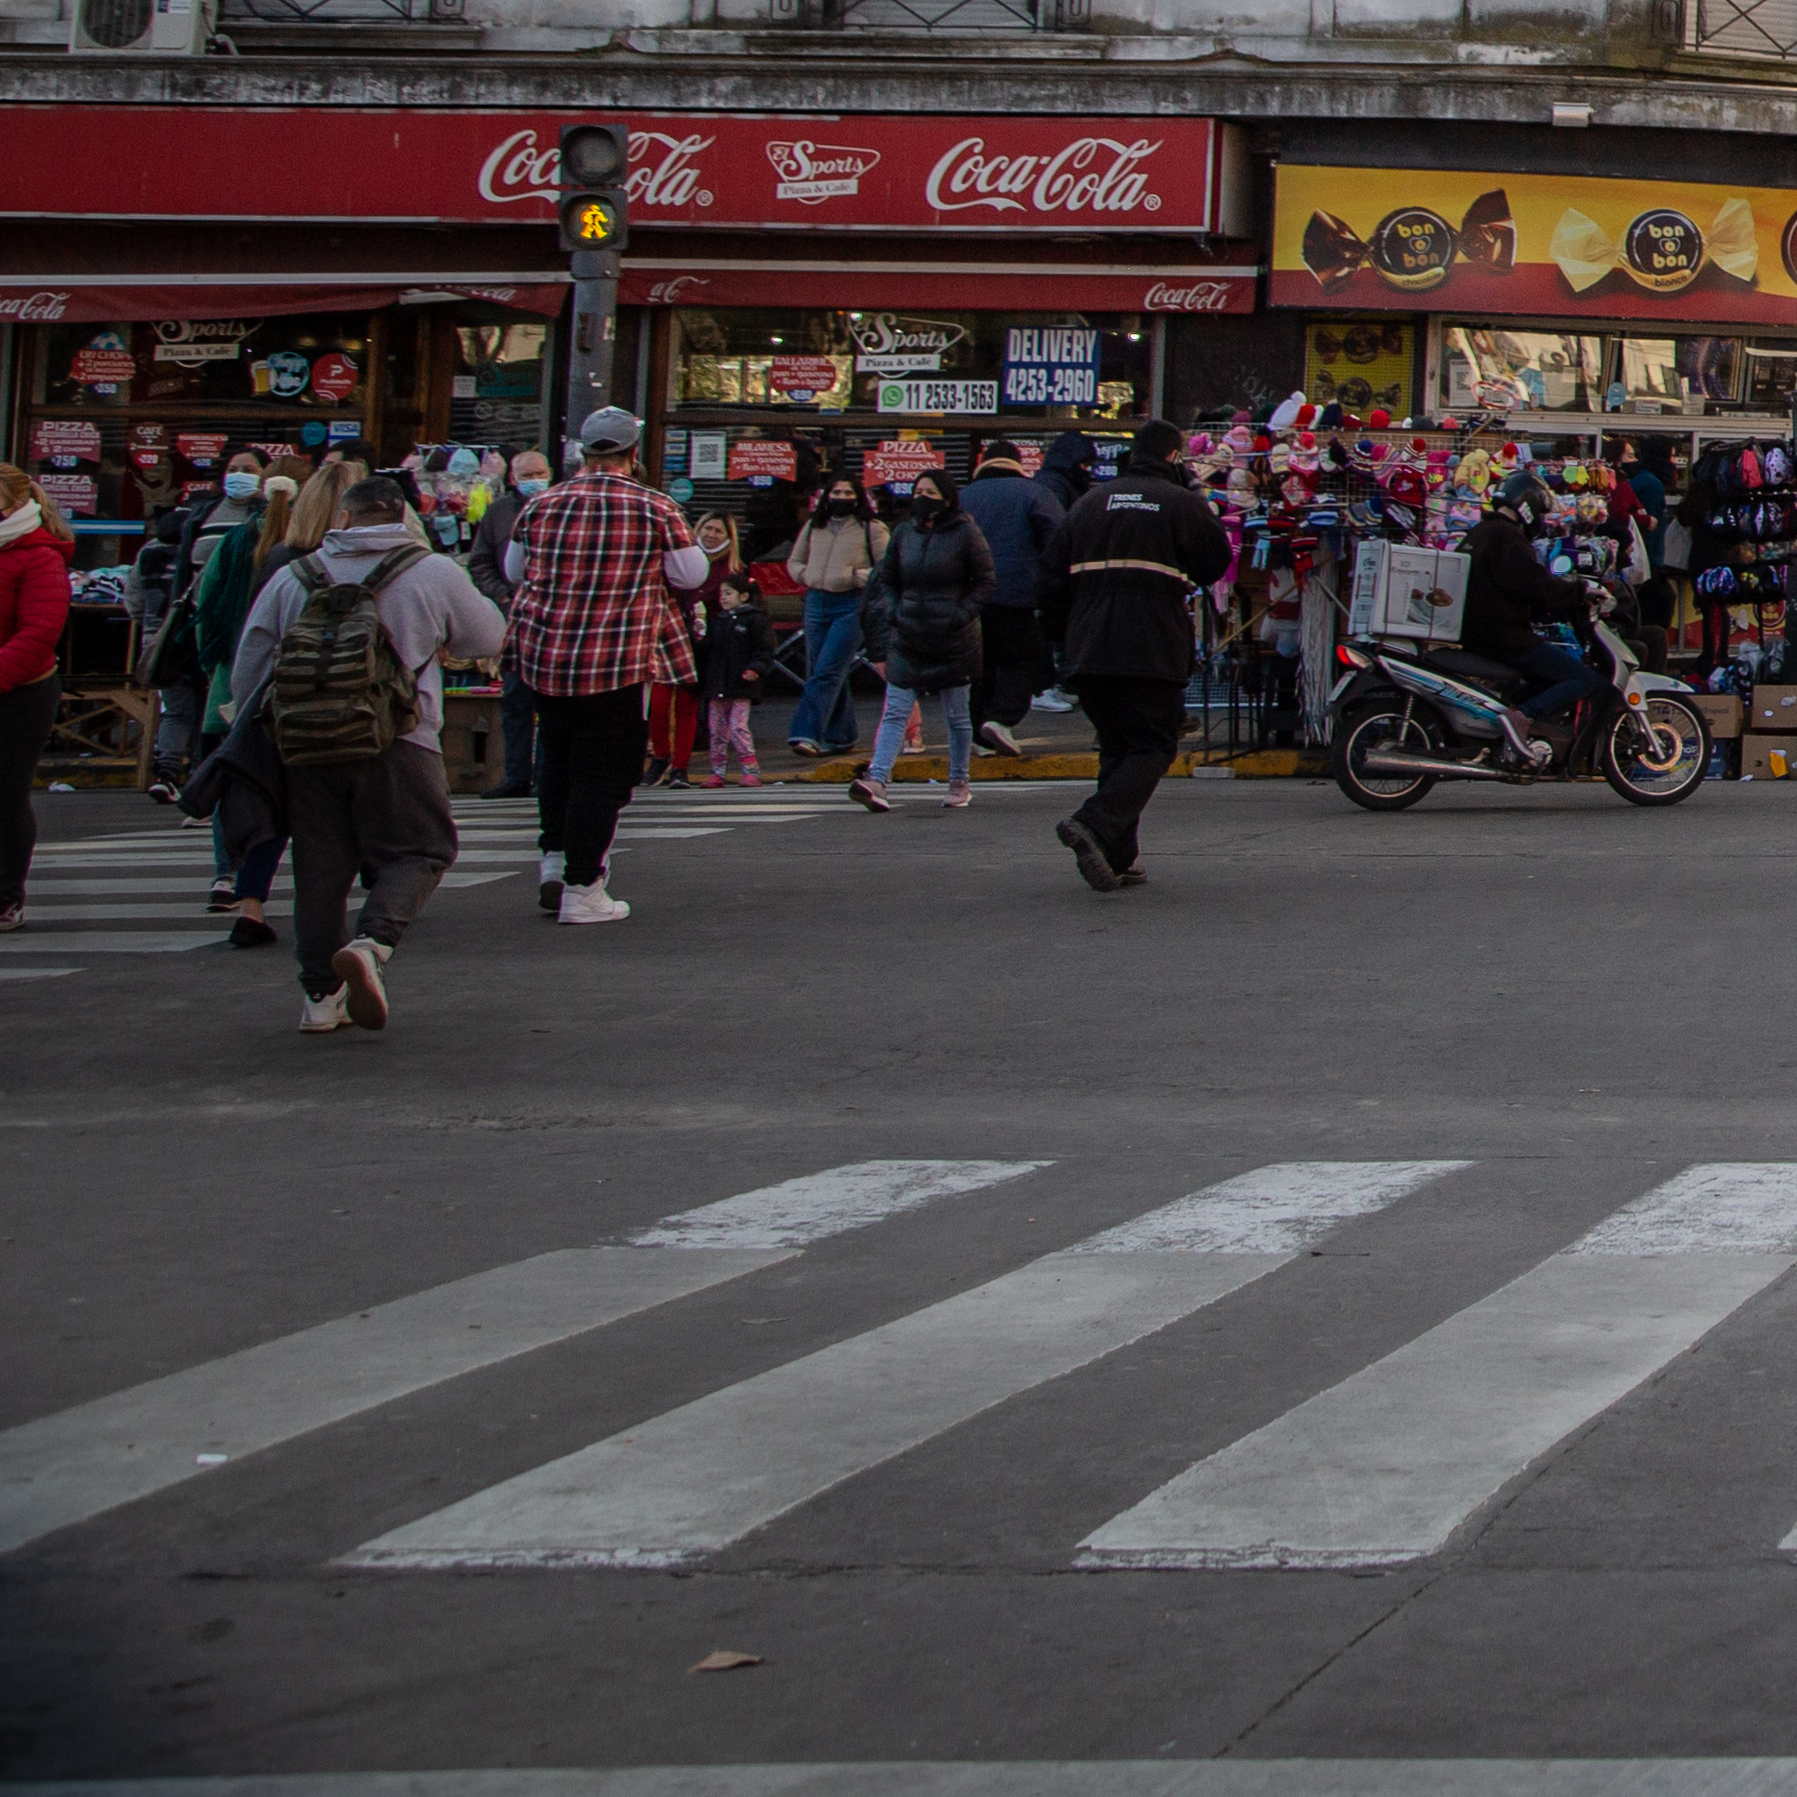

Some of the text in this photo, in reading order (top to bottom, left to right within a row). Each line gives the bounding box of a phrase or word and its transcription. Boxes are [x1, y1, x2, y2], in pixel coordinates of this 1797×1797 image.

[478, 129, 717, 206] Cocola
[780, 139, 864, 181] Sports
[925, 137, 1165, 212] Coca-Cola
[783, 184, 813, 196] Pizza
[813, 185, 824, 193] &
[1396, 223, 1435, 238] bon
[1649, 224, 1685, 238] bon
[1414, 239, 1427, 251] o
[1664, 241, 1676, 252] o
[1402, 252, 1440, 269] bon
[1652, 253, 1687, 269] bon
[861, 312, 949, 354] Sports
[1007, 328, 1098, 363] DELIVERY
[866, 357, 932, 368] Pizza & Café
[1005, 368, 1095, 403] 4253-2960
[905, 384, 995, 410] 11 2533-1563
[42, 420, 95, 432] PIZZA
[883, 441, 928, 453] PIZZA
[40, 474, 93, 485] PIZZA
